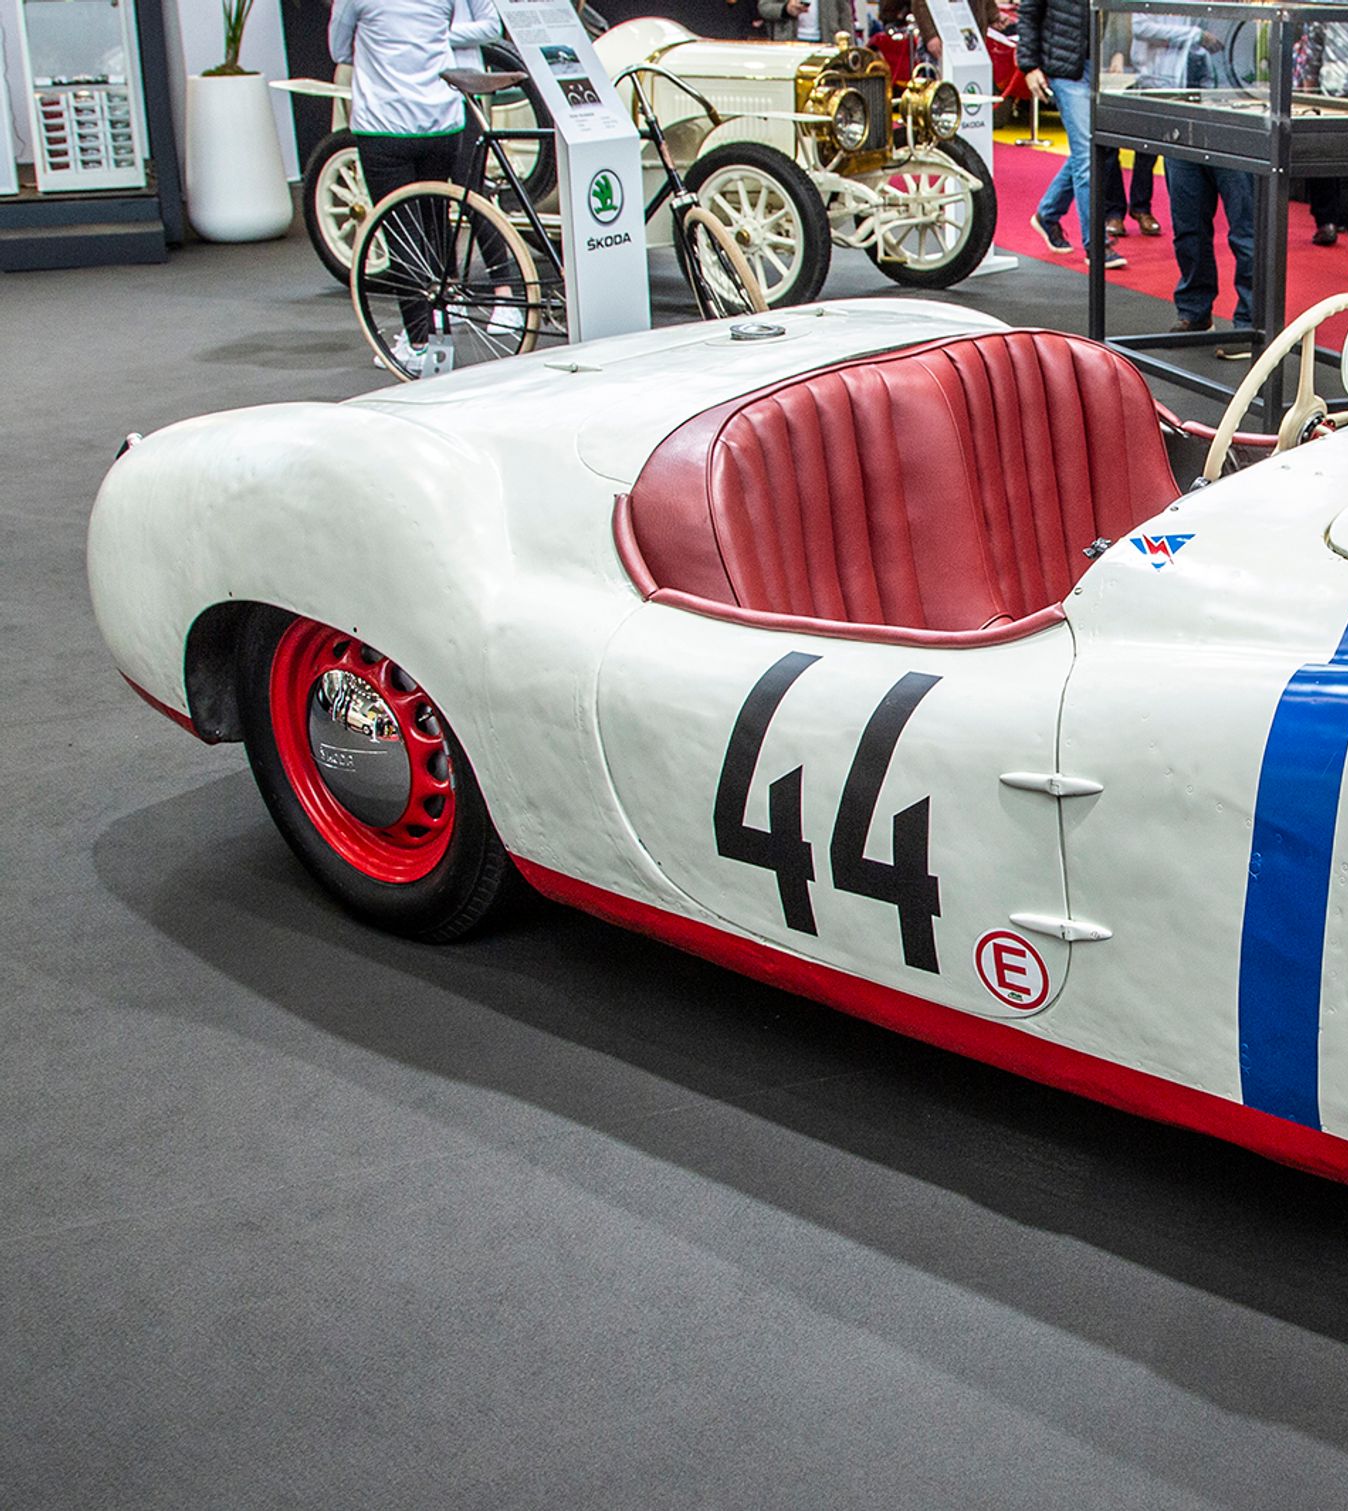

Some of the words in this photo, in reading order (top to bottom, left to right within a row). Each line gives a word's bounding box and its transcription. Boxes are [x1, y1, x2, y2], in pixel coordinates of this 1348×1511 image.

[587, 232, 631, 251] ŠKODA
[713, 650, 944, 975] 44
[992, 942, 1031, 996] E
